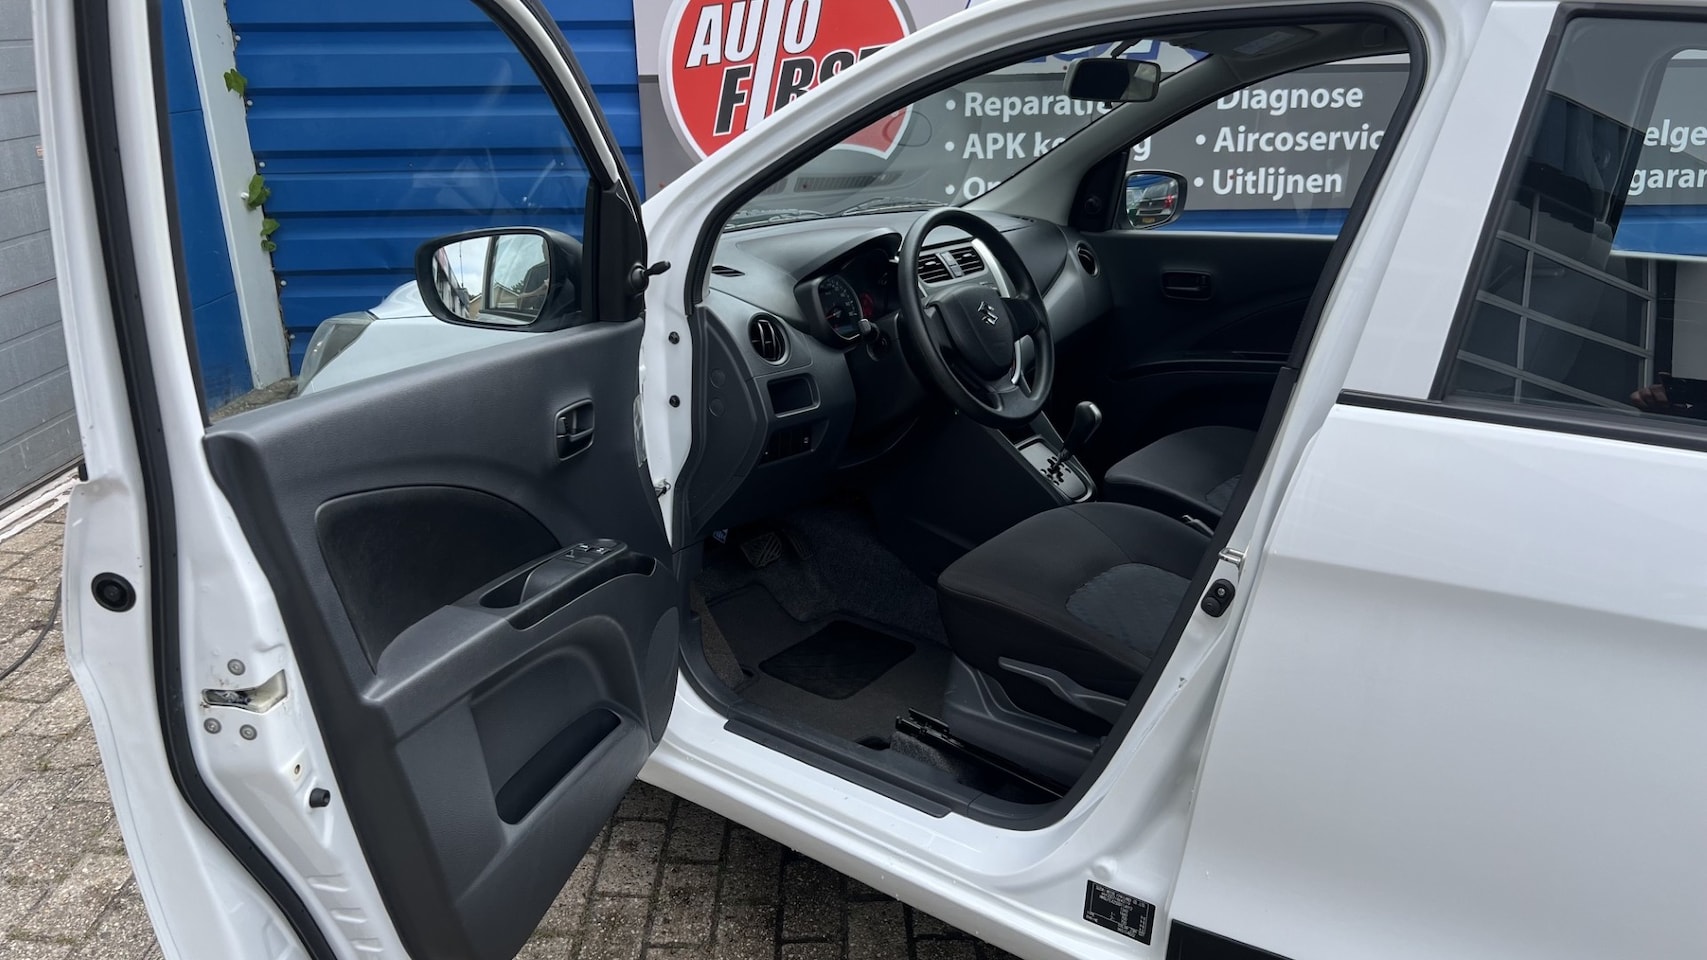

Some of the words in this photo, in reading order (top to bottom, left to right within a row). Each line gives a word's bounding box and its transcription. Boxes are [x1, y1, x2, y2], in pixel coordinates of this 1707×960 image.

[1217, 86, 1364, 116] Diagnose
[962, 132, 1026, 160] APK
[1212, 166, 1343, 201] Uitlijnen
